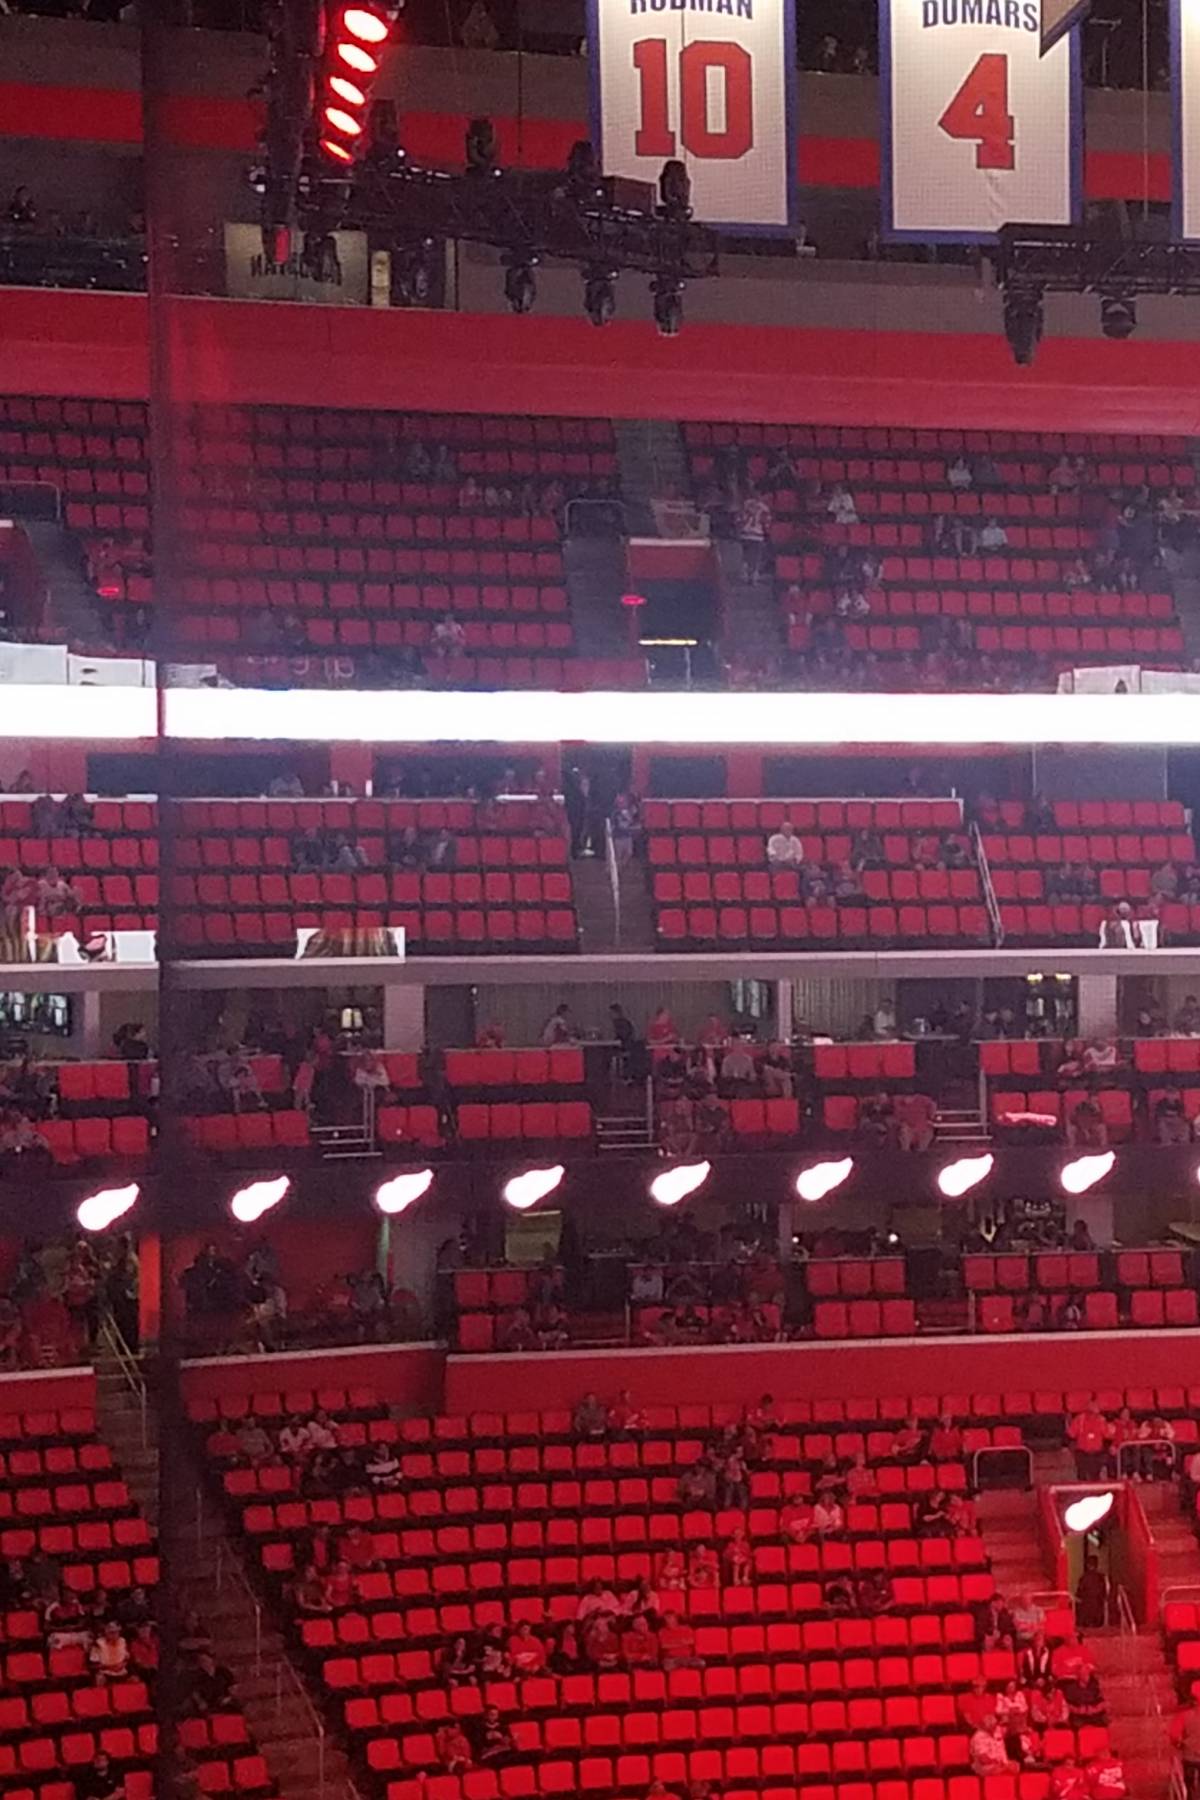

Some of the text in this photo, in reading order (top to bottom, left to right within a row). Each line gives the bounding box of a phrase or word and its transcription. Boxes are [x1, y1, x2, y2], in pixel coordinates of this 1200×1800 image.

[922, 0, 1038, 32] DUMARS
[633, 38, 754, 160] 10
[937, 52, 1015, 170] 4
